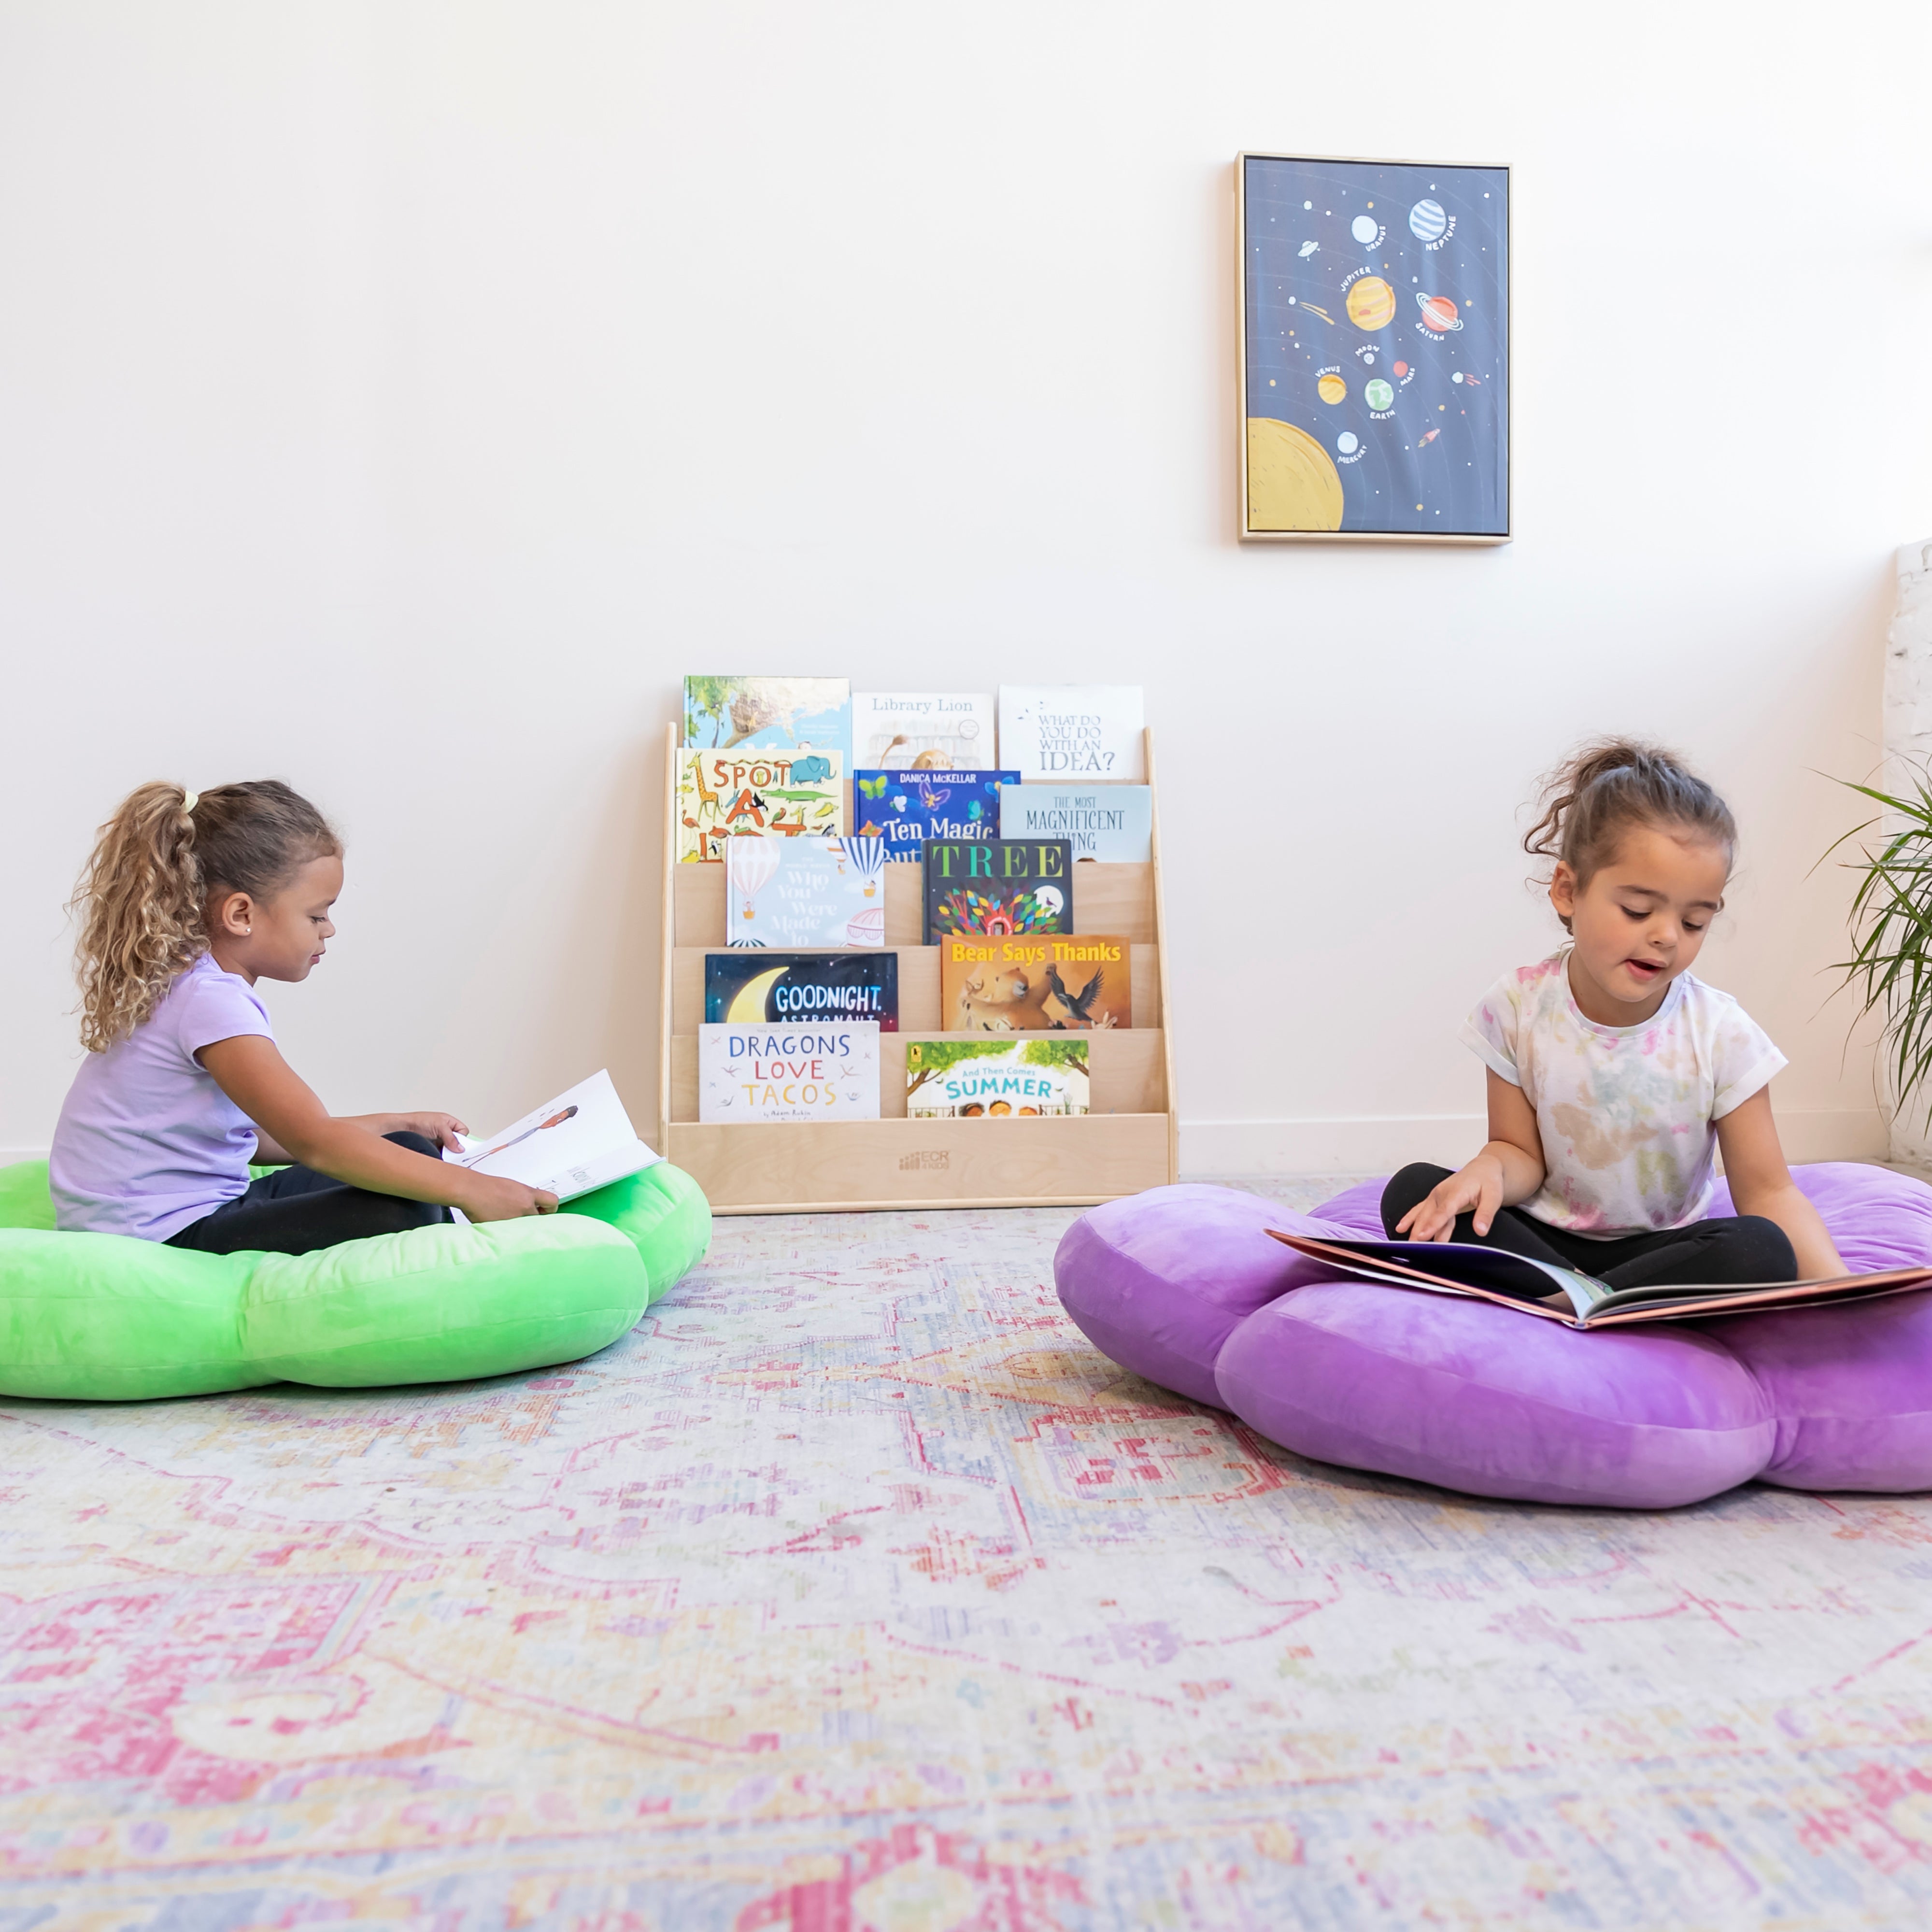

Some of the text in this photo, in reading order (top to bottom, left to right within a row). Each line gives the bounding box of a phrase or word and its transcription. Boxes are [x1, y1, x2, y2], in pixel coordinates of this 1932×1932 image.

[1365, 225, 1386, 252] URANUS
[1425, 215, 1457, 251] NEPTUNE
[1340, 266, 1372, 292] JUPITER
[1415, 322, 1445, 341] SATURN
[1355, 344, 1380, 356] MOON
[1314, 366, 1340, 378] VENUS
[1400, 368, 1416, 386] MARS
[1370, 409, 1395, 420] EARTH
[1337, 444, 1367, 464] MERCURY
[872, 698, 973, 714] Library Lion
[1038, 715, 1101, 725] WHAT DO
[1039, 726, 1101, 739] YOU DO
[1039, 739, 1101, 751] WITH AN
[1039, 751, 1116, 771] IDEA?
[713, 760, 793, 789] SPOT
[900, 773, 977, 784] DANICA McKELLAR
[725, 788, 765, 827] A
[1053, 796, 1097, 809] THE MOST
[883, 818, 922, 842] Ten
[1025, 810, 1125, 830] MAGNIFICENT
[932, 846, 1064, 878] TREE
[787, 871, 829, 892] Who
[777, 885, 811, 899] You
[791, 901, 838, 916] Were
[771, 915, 821, 936] Made
[952, 942, 1122, 966] Bear Says Thanks
[729, 1035, 851, 1057] DRAGONS
[755, 1060, 824, 1080] LOVE
[962, 1067, 1036, 1078] And Then Comes
[741, 1082, 837, 1106] TACOS
[945, 1077, 1052, 1100] SUMMER
[921, 1151, 949, 1162] ECR
